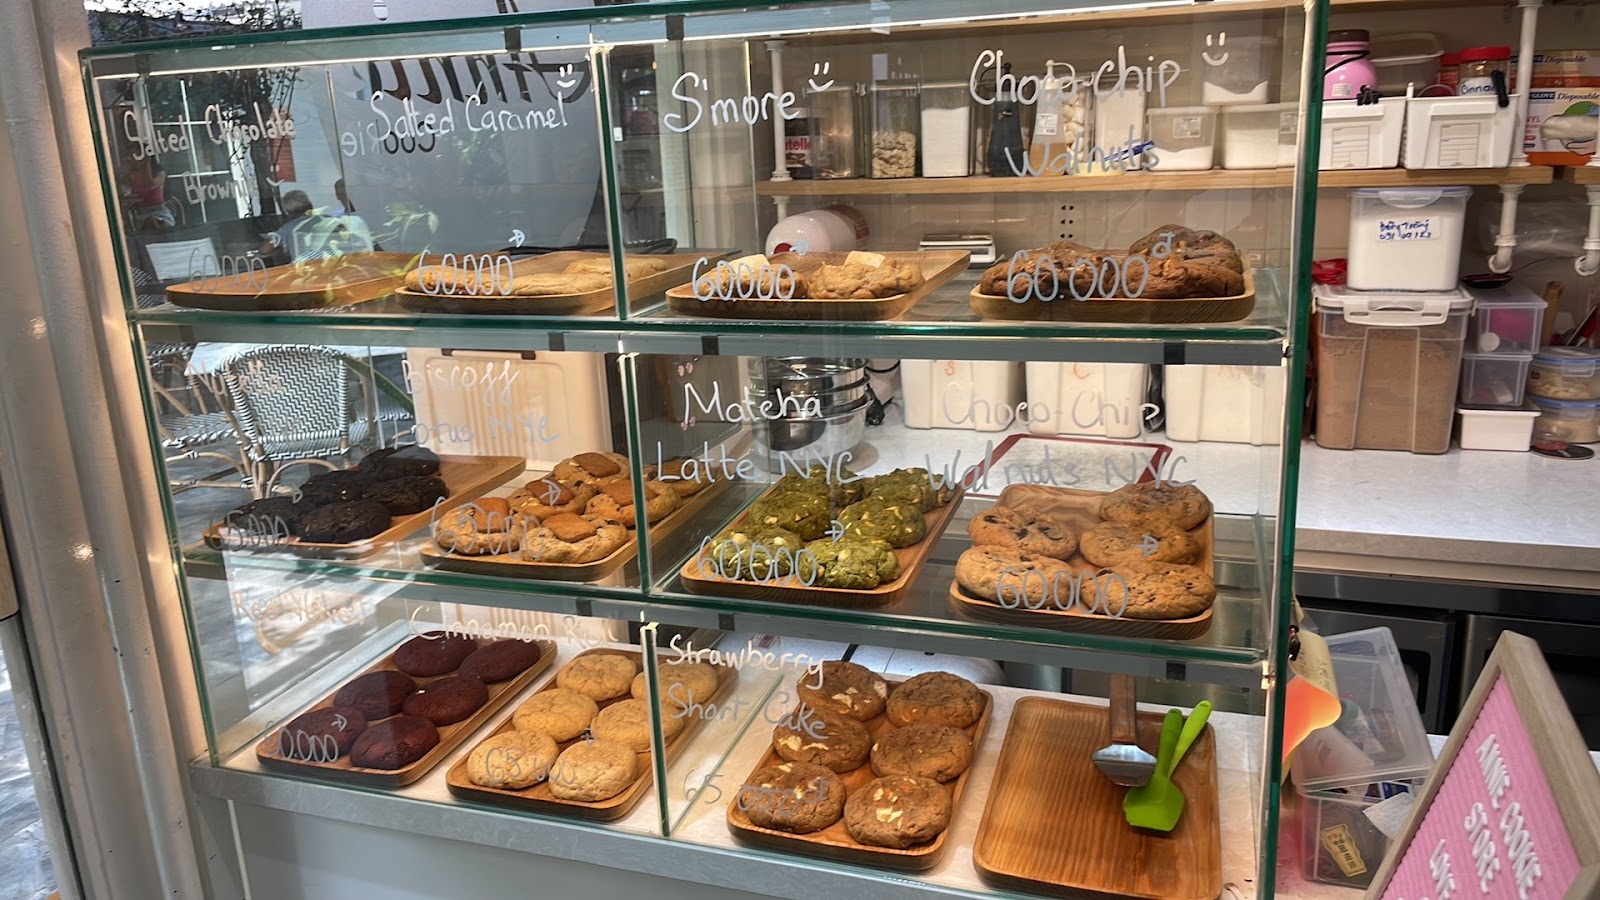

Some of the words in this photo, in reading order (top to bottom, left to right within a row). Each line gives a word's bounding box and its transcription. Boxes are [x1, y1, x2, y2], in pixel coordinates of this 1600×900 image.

[370, 90, 455, 141] Salted
[465, 86, 569, 132] Caramel
[664, 72, 799, 132] S'more
[124, 110, 190, 162] Salted
[205, 101, 296, 146] Chocolate
[1004, 124, 1160, 177] Walnuts
[418, 250, 514, 296] 60.000
[1007, 250, 1150, 304] 60.000
[683, 380, 823, 425] Matcha
[657, 441, 757, 483] Latte
[779, 450, 866, 485] NYC
[1103, 450, 1196, 489] NYC
[697, 535, 817, 587] 60.000
[409, 605, 552, 643] Cinnamon
[666, 633, 825, 690] Strawberry
[666, 682, 750, 723] Short
[763, 691, 830, 740] Cake
